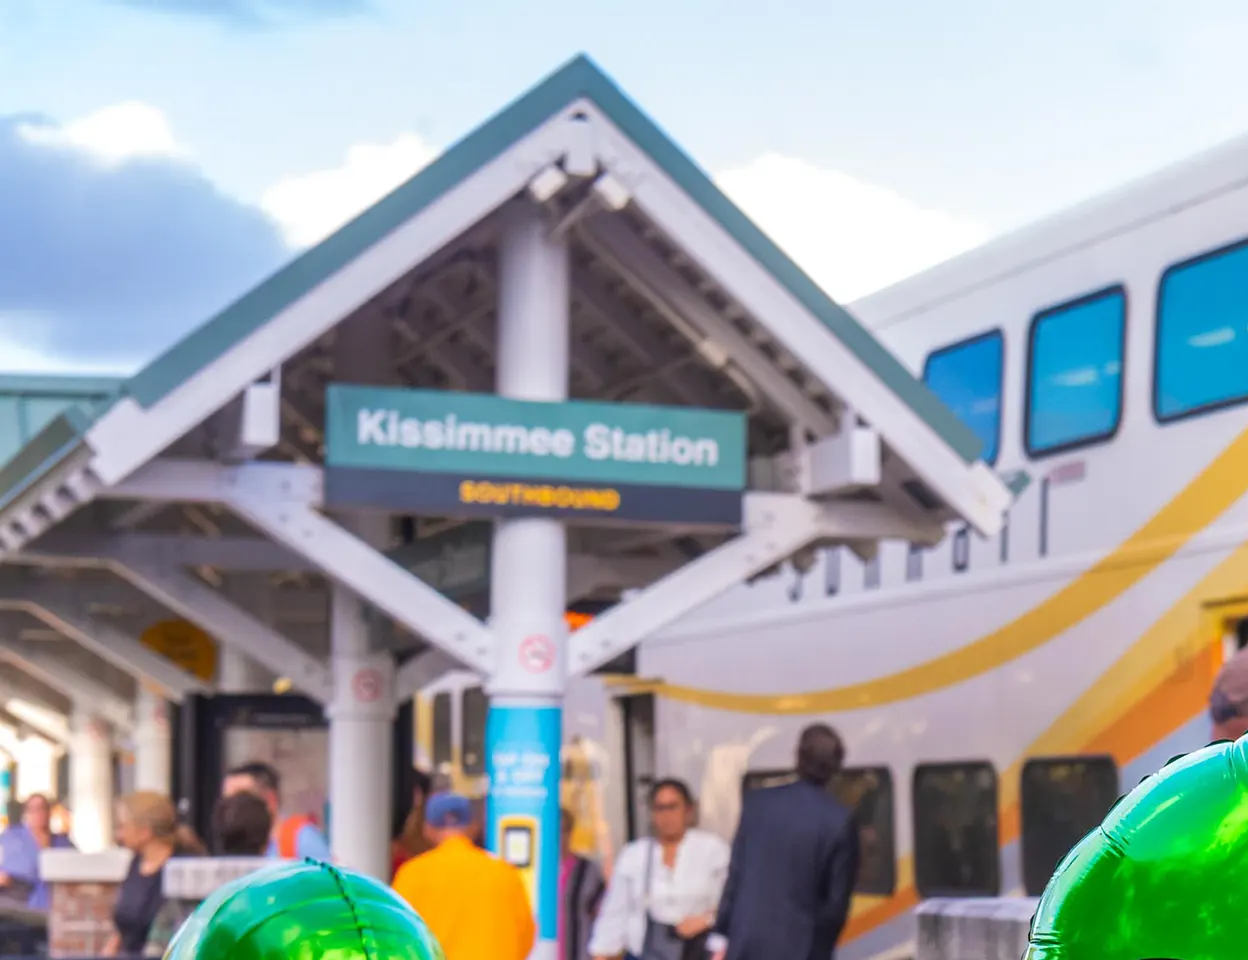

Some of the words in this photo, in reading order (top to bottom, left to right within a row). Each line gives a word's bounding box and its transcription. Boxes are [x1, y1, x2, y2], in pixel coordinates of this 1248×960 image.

[357, 408, 576, 458] Kissimmee
[583, 424, 719, 467] Station
[459, 479, 621, 512] SOUTHBOUND
